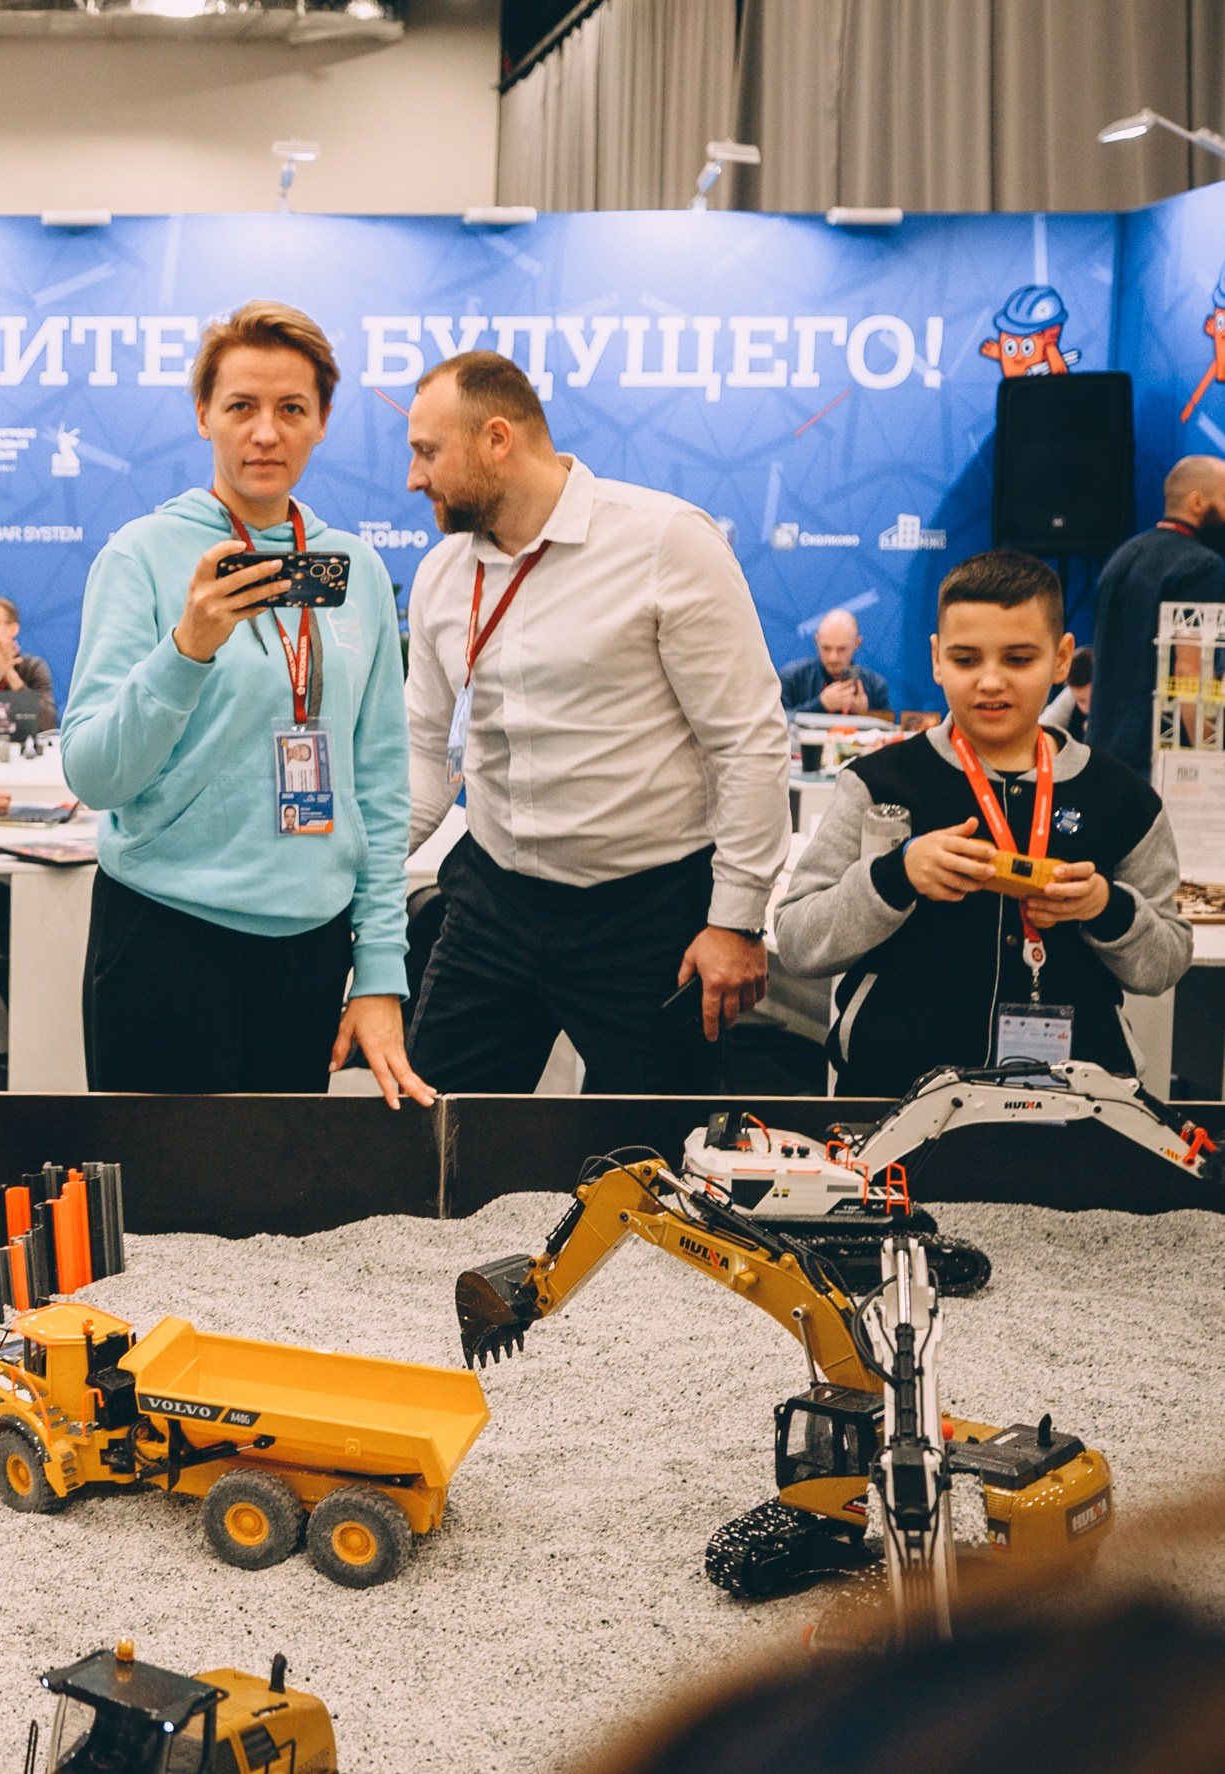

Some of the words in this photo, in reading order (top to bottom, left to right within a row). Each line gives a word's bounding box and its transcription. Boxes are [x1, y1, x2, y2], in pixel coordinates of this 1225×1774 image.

[360, 314, 944, 402] БУДУЩЕГО!
[24, 525, 83, 542] SYSTEM
[360, 530, 429, 549] ДОБРО
[799, 532, 860, 547] Сколково
[1004, 1100, 1043, 1110] HUINA
[679, 1236, 729, 1270] HUINA
[147, 1397, 212, 1418] VOLVO
[230, 1412, 251, 1425] A40G
